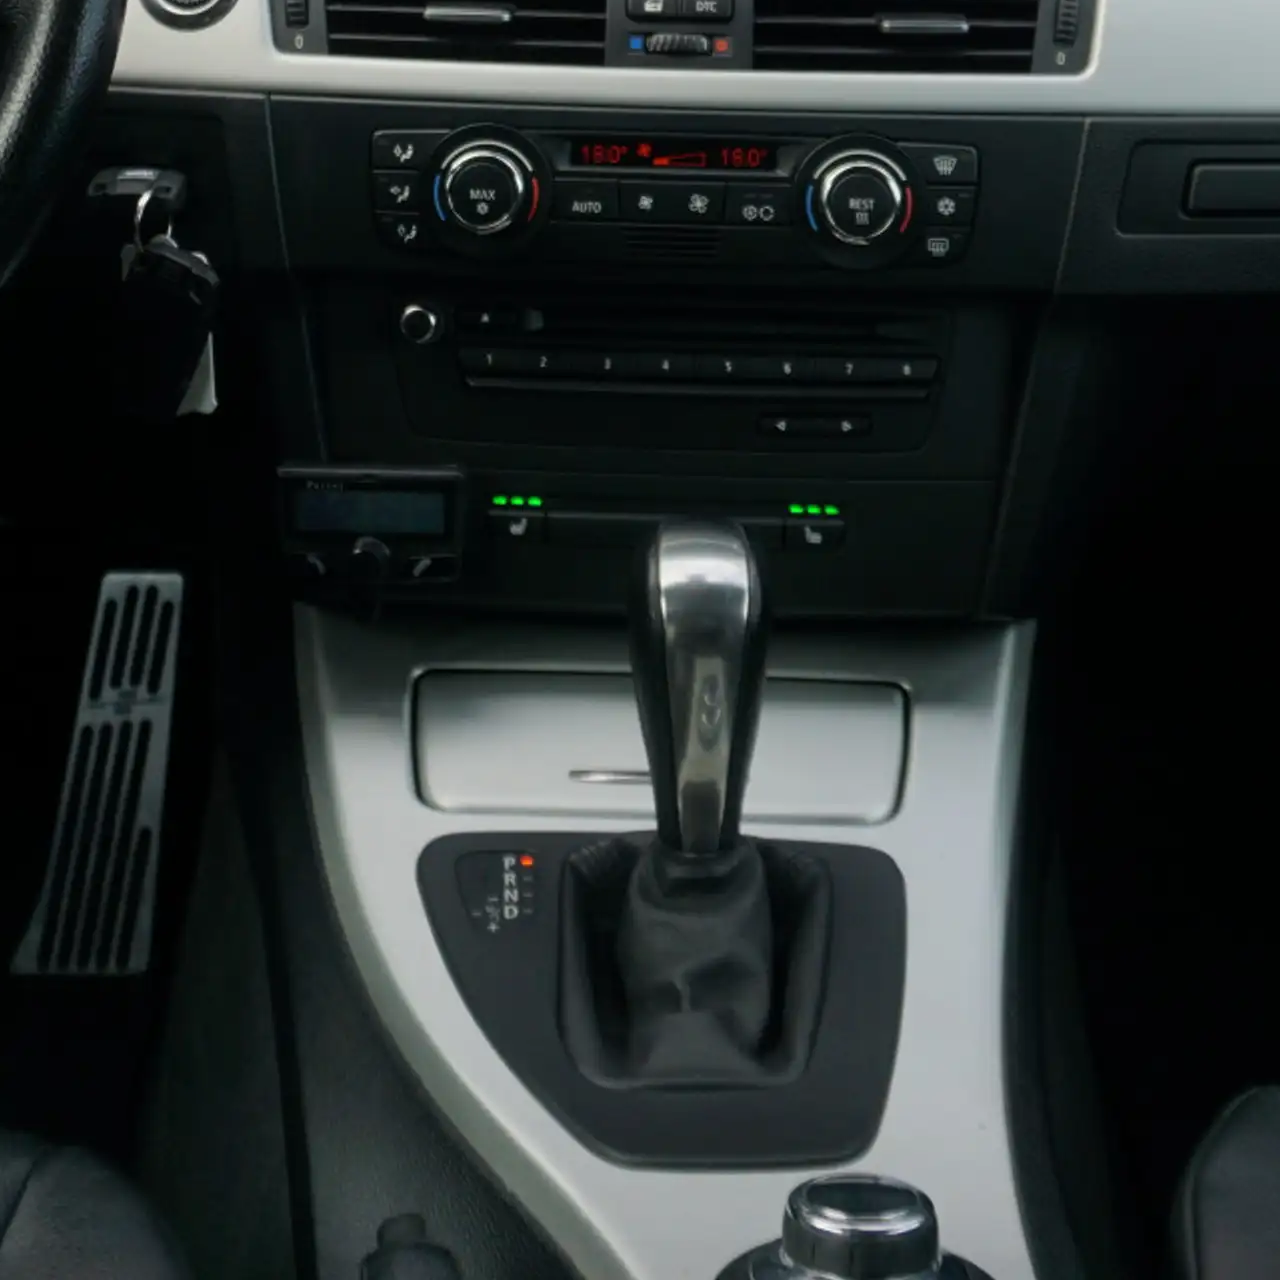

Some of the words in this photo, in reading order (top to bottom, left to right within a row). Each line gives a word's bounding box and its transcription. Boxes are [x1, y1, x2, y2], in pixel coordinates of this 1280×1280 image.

[695, 0, 718, 13] DTC
[469, 188, 496, 200] MAX
[572, 200, 602, 214] AUTO
[848, 198, 875, 210] REST
[539, 355, 548, 368] 2
[503, 854, 516, 871] P
[503, 872, 517, 887] R
[503, 888, 519, 903] N
[503, 904, 519, 920] D
